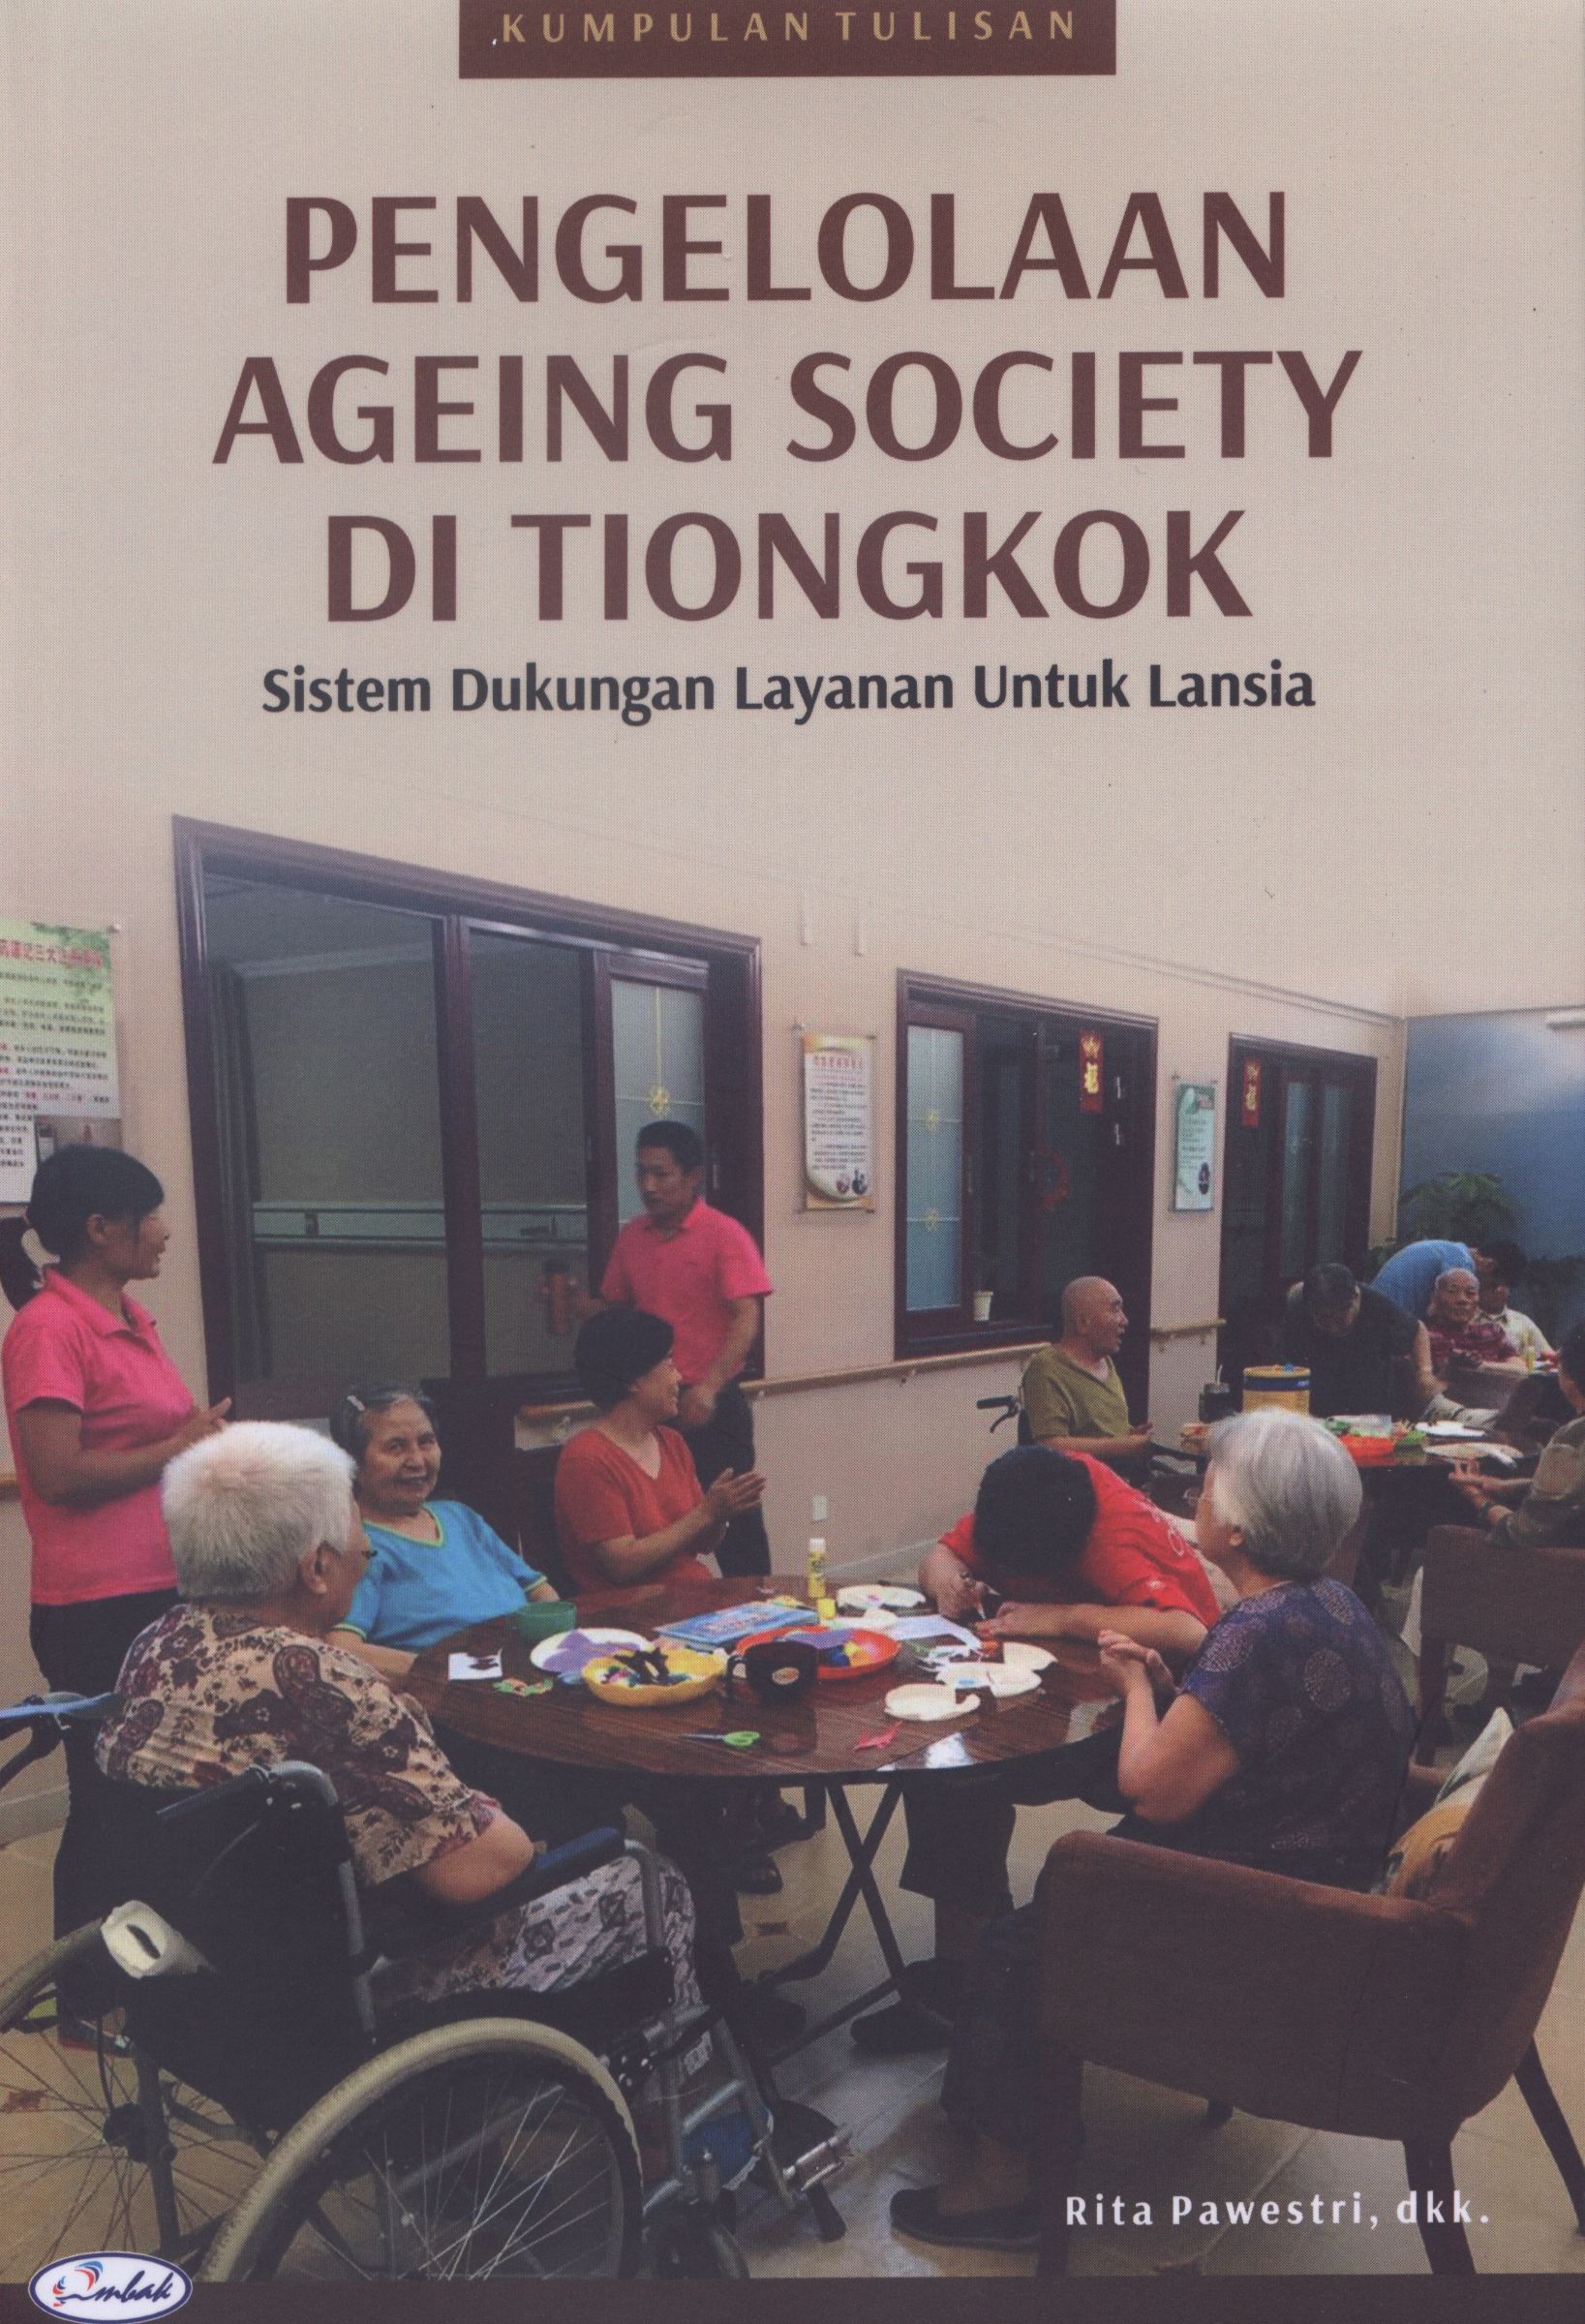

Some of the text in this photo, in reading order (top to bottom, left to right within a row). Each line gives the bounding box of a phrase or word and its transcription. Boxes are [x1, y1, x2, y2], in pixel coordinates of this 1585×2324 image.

[502, 10, 1074, 43] KUMPULAN TULISAN
[287, 191, 1286, 304] PENGELOLAAN
[213, 350, 1362, 466] AGEING SOCIETY
[328, 508, 1253, 623] DI TIONGKOK
[262, 658, 1317, 726] Sistem Dukungan Layanan Untuk Lansia
[1066, 2189, 1490, 2229] Rita Pawestri, dkk.
